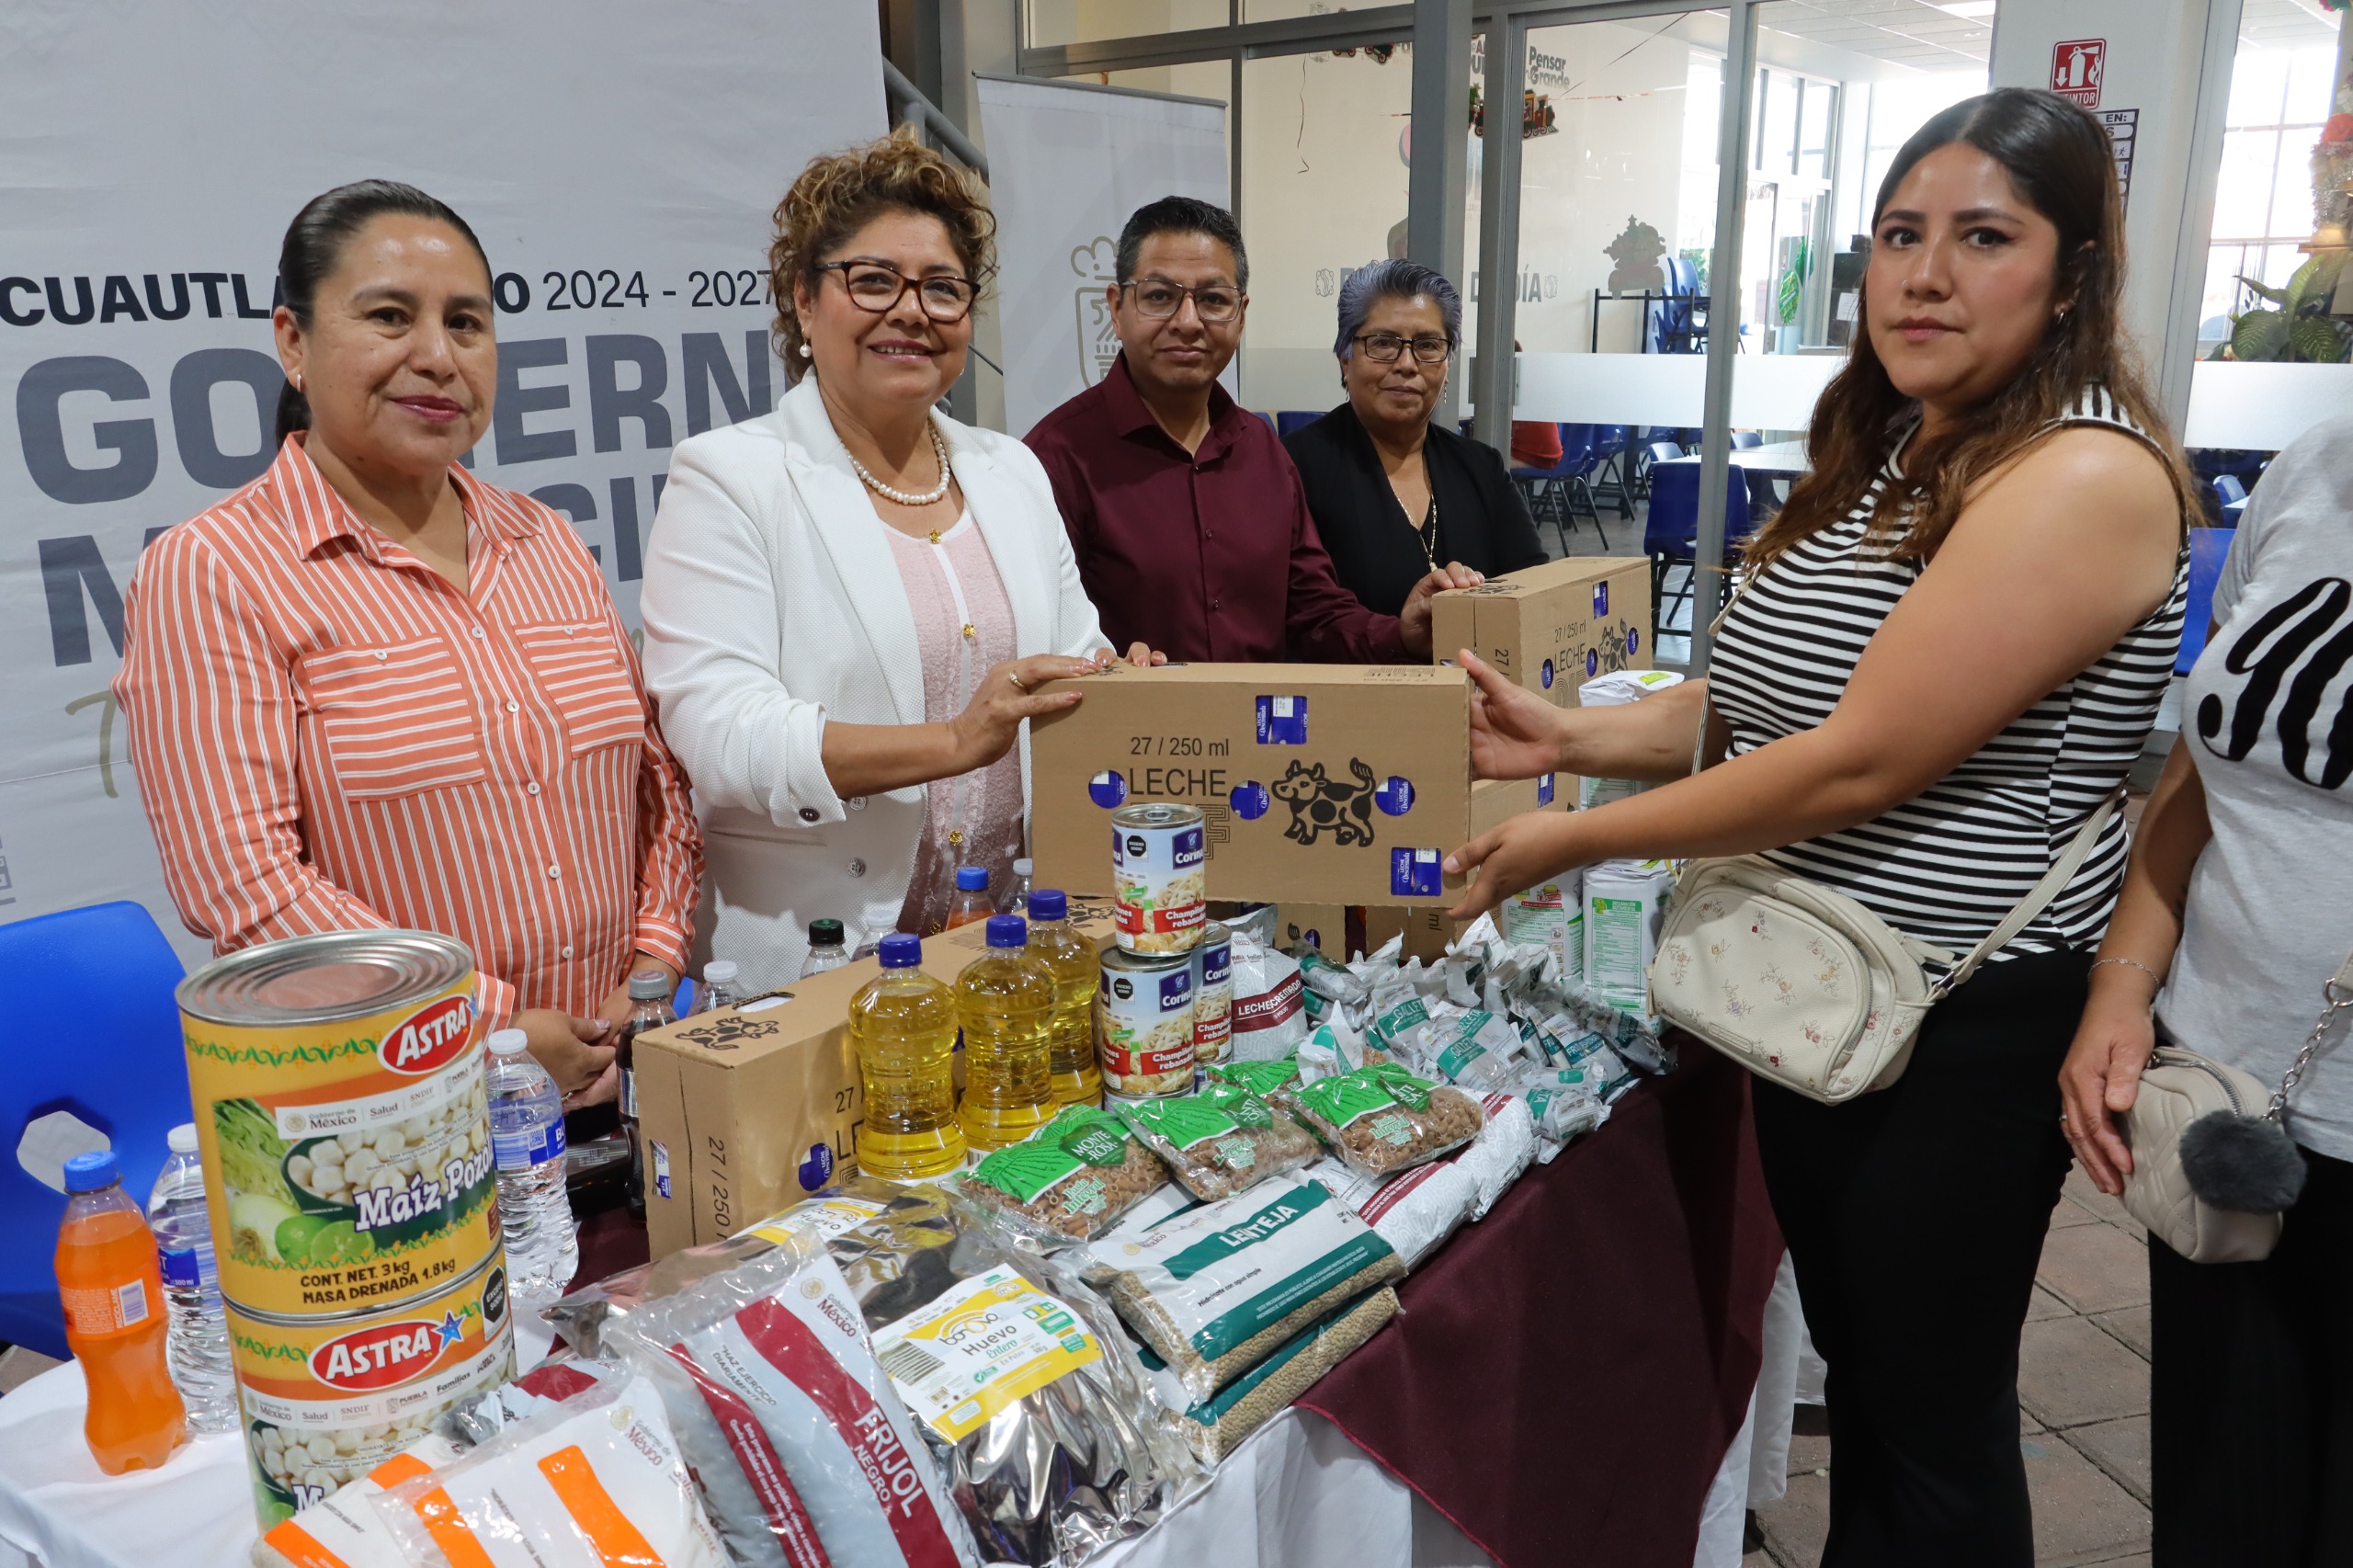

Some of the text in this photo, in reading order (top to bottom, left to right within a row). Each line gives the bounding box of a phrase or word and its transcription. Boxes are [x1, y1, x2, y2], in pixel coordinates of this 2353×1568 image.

[1529, 46, 1566, 73] Pensar
[1529, 65, 1570, 90] Grande
[2105, 113, 2128, 123] EN:
[542, 269, 650, 312] 2024
[1554, 629, 1563, 644] 27
[1567, 622, 1579, 640] 250
[1495, 648, 1509, 666] 27
[1553, 643, 1586, 675] LECHE
[1131, 736, 1153, 756] 27
[1169, 737, 1203, 756] 250
[1209, 738, 1230, 756] ml
[1130, 767, 1228, 797] LECHE
[1238, 1001, 1271, 1016] LECHE
[396, 1000, 468, 1067] ASTRA
[369, 1102, 399, 1116] Salud
[835, 1086, 855, 1114] 27
[310, 1114, 357, 1130] México
[1369, 1114, 1410, 1140] Integral
[708, 1135, 726, 1166] 27
[1071, 1130, 1112, 1157] MONTE
[354, 1174, 442, 1233] Maíz
[445, 1130, 494, 1203] Pozol
[1062, 1178, 1089, 1199] Pasta
[1062, 1177, 1106, 1214] Integral
[712, 1184, 732, 1228] 250
[1218, 1204, 1299, 1248] LENTEJA
[301, 1274, 344, 1288] CONT.
[347, 1267, 378, 1283] NET.
[1245, 1267, 1262, 1279] simple
[302, 1290, 347, 1304] MASA
[349, 1274, 419, 1298] DRENADA
[816, 1298, 857, 1338] México
[826, 1292, 858, 1324] Gobierno
[325, 1325, 433, 1381] ASTRA
[961, 1324, 1017, 1357] Huevo
[985, 1339, 1018, 1359] Entero
[437, 1371, 471, 1393] Familias
[735, 1366, 778, 1407] EJERCICIO
[340, 1404, 370, 1415] SNDIF
[399, 1391, 428, 1403] PUEBLA
[260, 1404, 292, 1421] México
[301, 1411, 329, 1420] Salud
[625, 1426, 664, 1467] México
[635, 1419, 664, 1449] Gobierno
[749, 1437, 776, 1475] programa
[854, 1405, 925, 1518] FRIJOL
[853, 1443, 892, 1502] NEGRO
